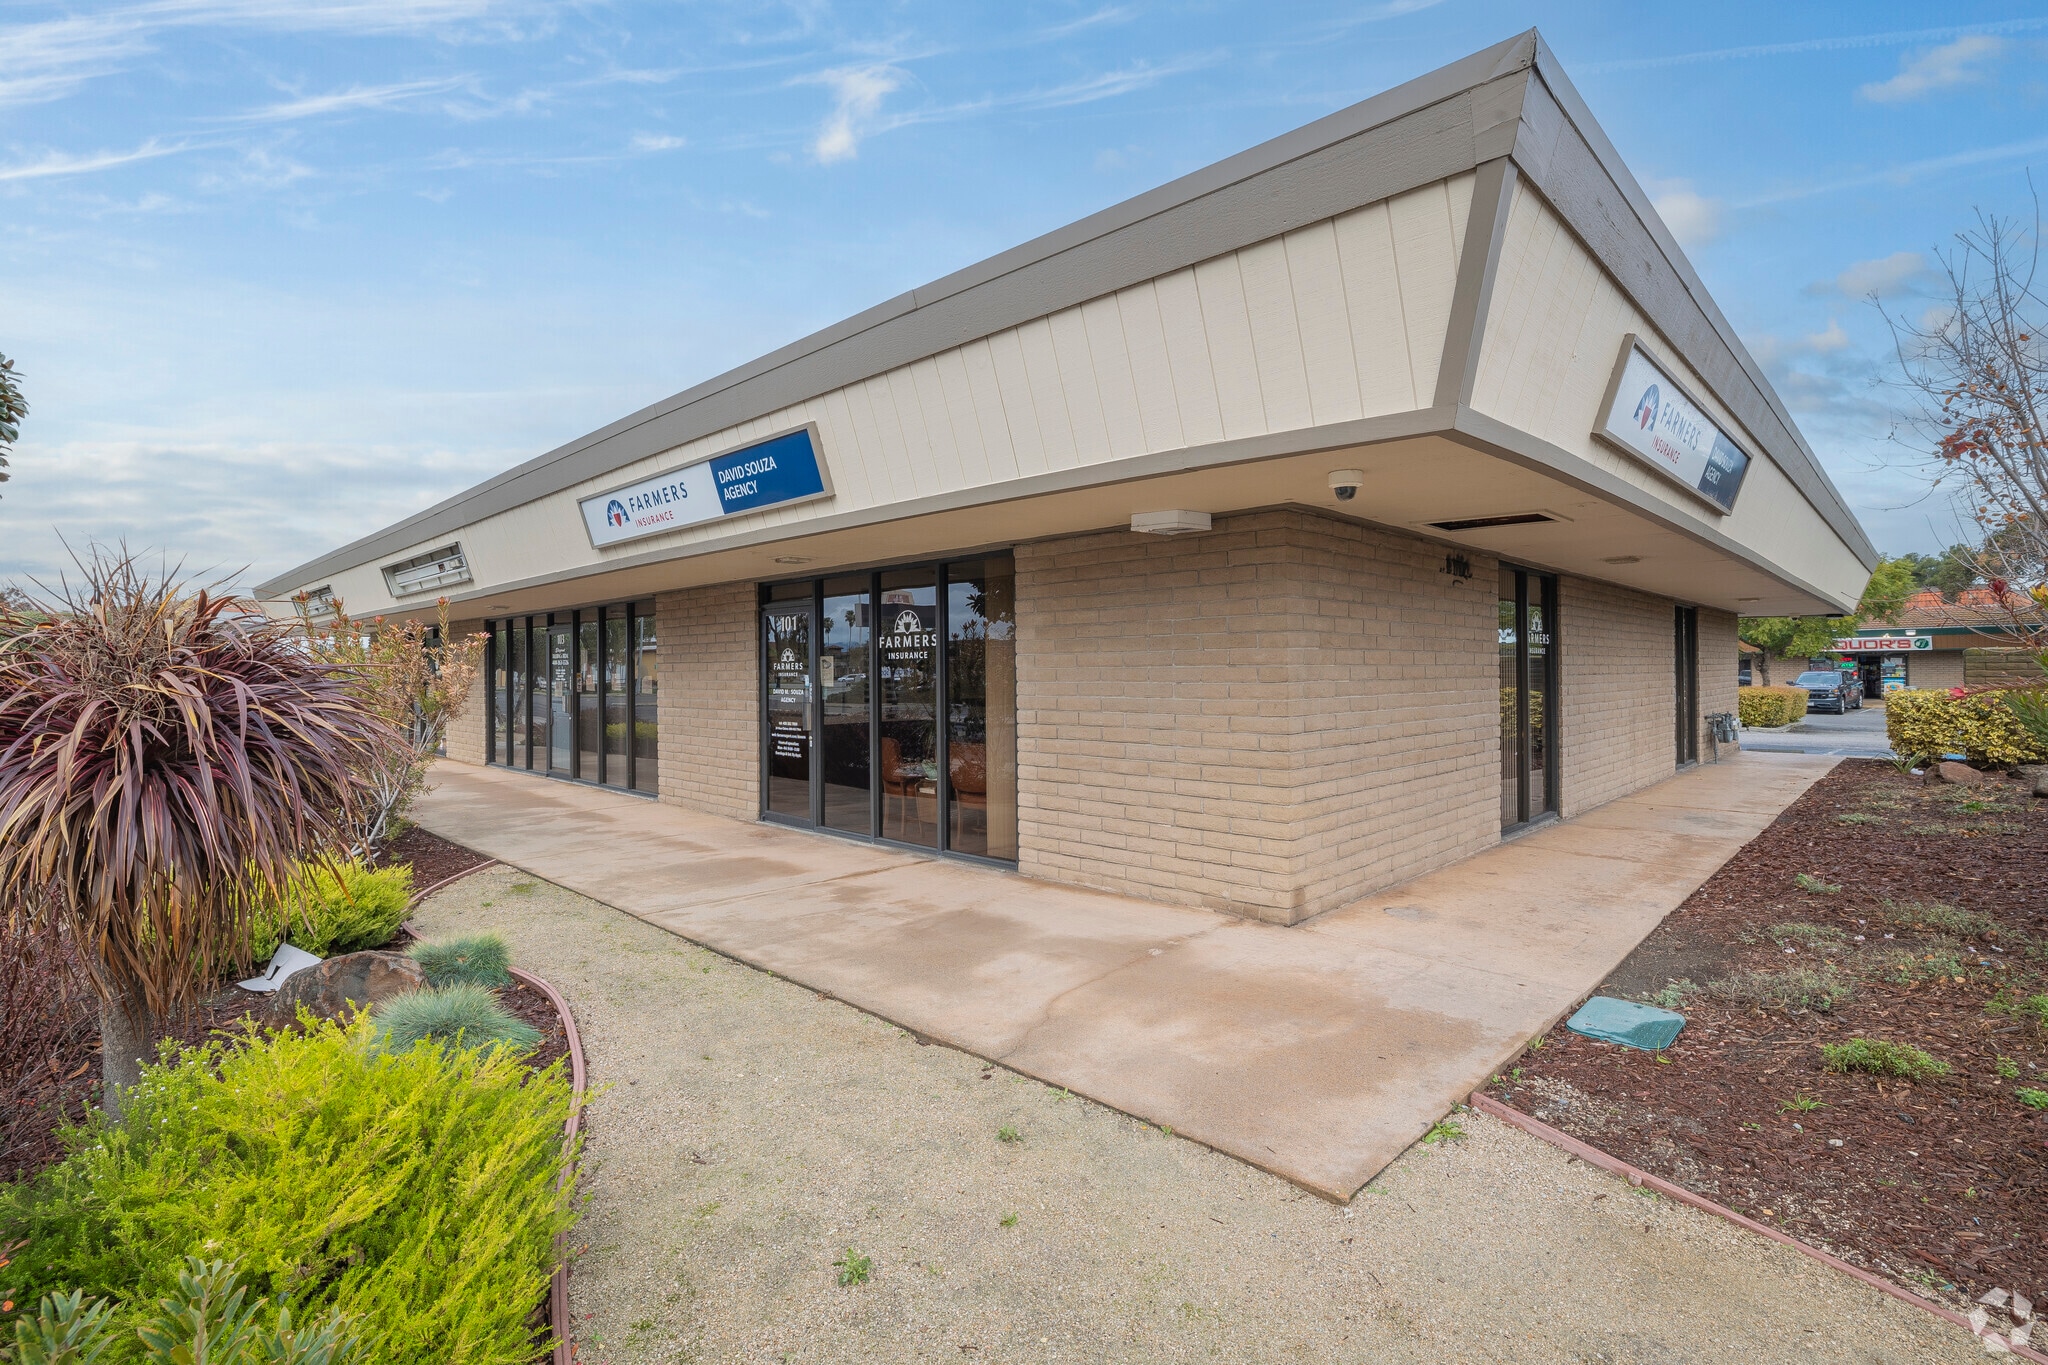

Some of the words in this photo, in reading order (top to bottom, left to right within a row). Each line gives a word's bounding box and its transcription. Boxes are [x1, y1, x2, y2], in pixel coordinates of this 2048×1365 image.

[1659, 402, 1701, 451] FARMERS
[1652, 435, 1681, 465] INSURANCE
[718, 466, 745, 484] DAVID
[745, 456, 777, 477] SOUZA
[628, 482, 688, 513] FARMERS
[723, 480, 759, 501] AGENCY
[635, 510, 674, 528] INSURANCE
[780, 615, 797, 631] 101
[879, 634, 937, 648] FARMERS
[888, 651, 928, 660] INSURANCE
[773, 662, 803, 671] FARMERS
